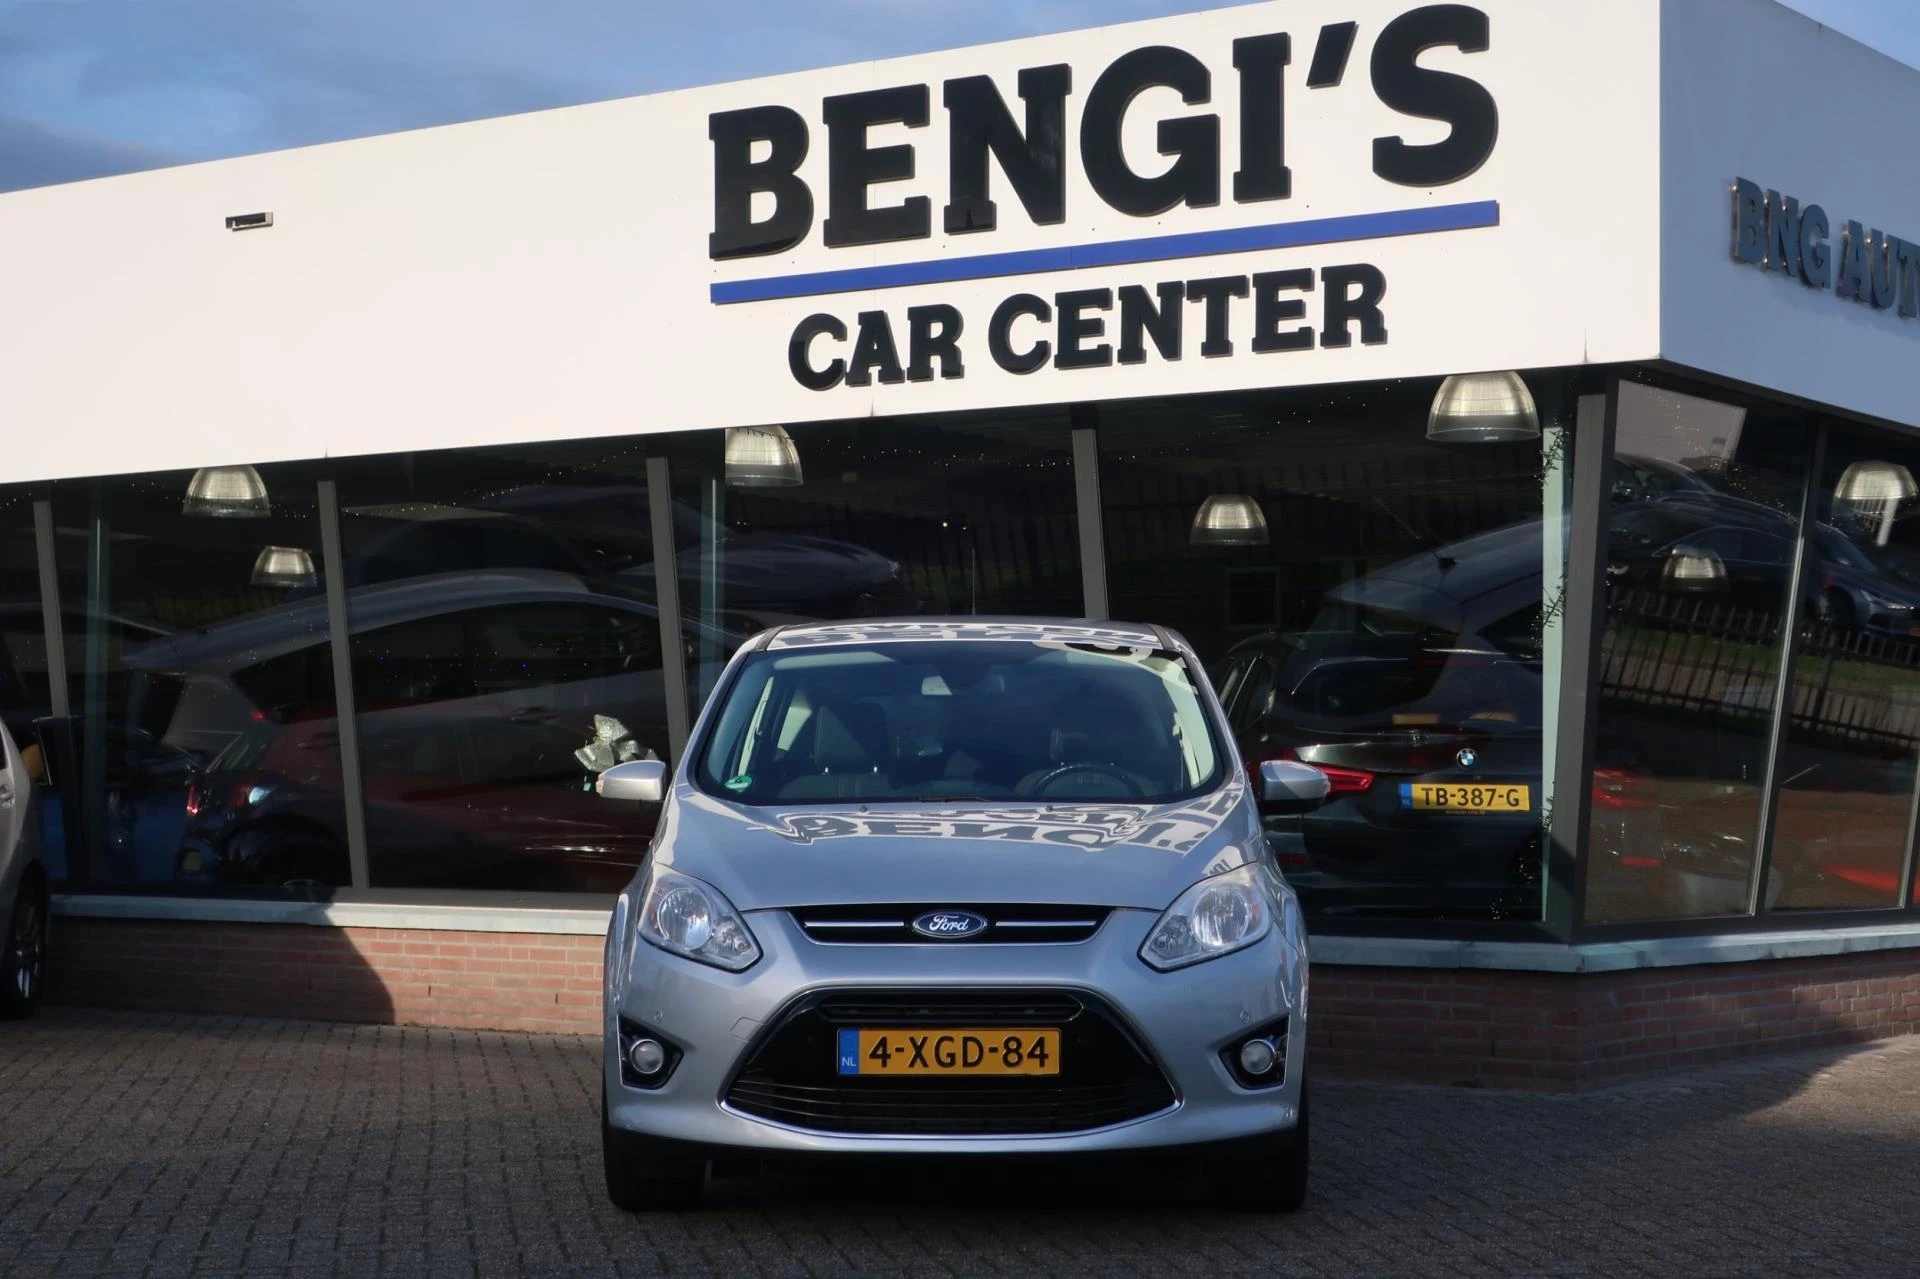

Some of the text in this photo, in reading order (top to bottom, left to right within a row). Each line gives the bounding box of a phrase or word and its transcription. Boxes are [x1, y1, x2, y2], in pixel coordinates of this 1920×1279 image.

[709, 3, 1499, 260] BENGI'S
[1731, 176, 1920, 319] BNG AUT
[788, 262, 1388, 391] CAR CENTER
[1421, 787, 1520, 807] TB-387-G
[929, 914, 970, 931] Ford
[841, 1036, 1049, 1068] NL 4-XGD-84
